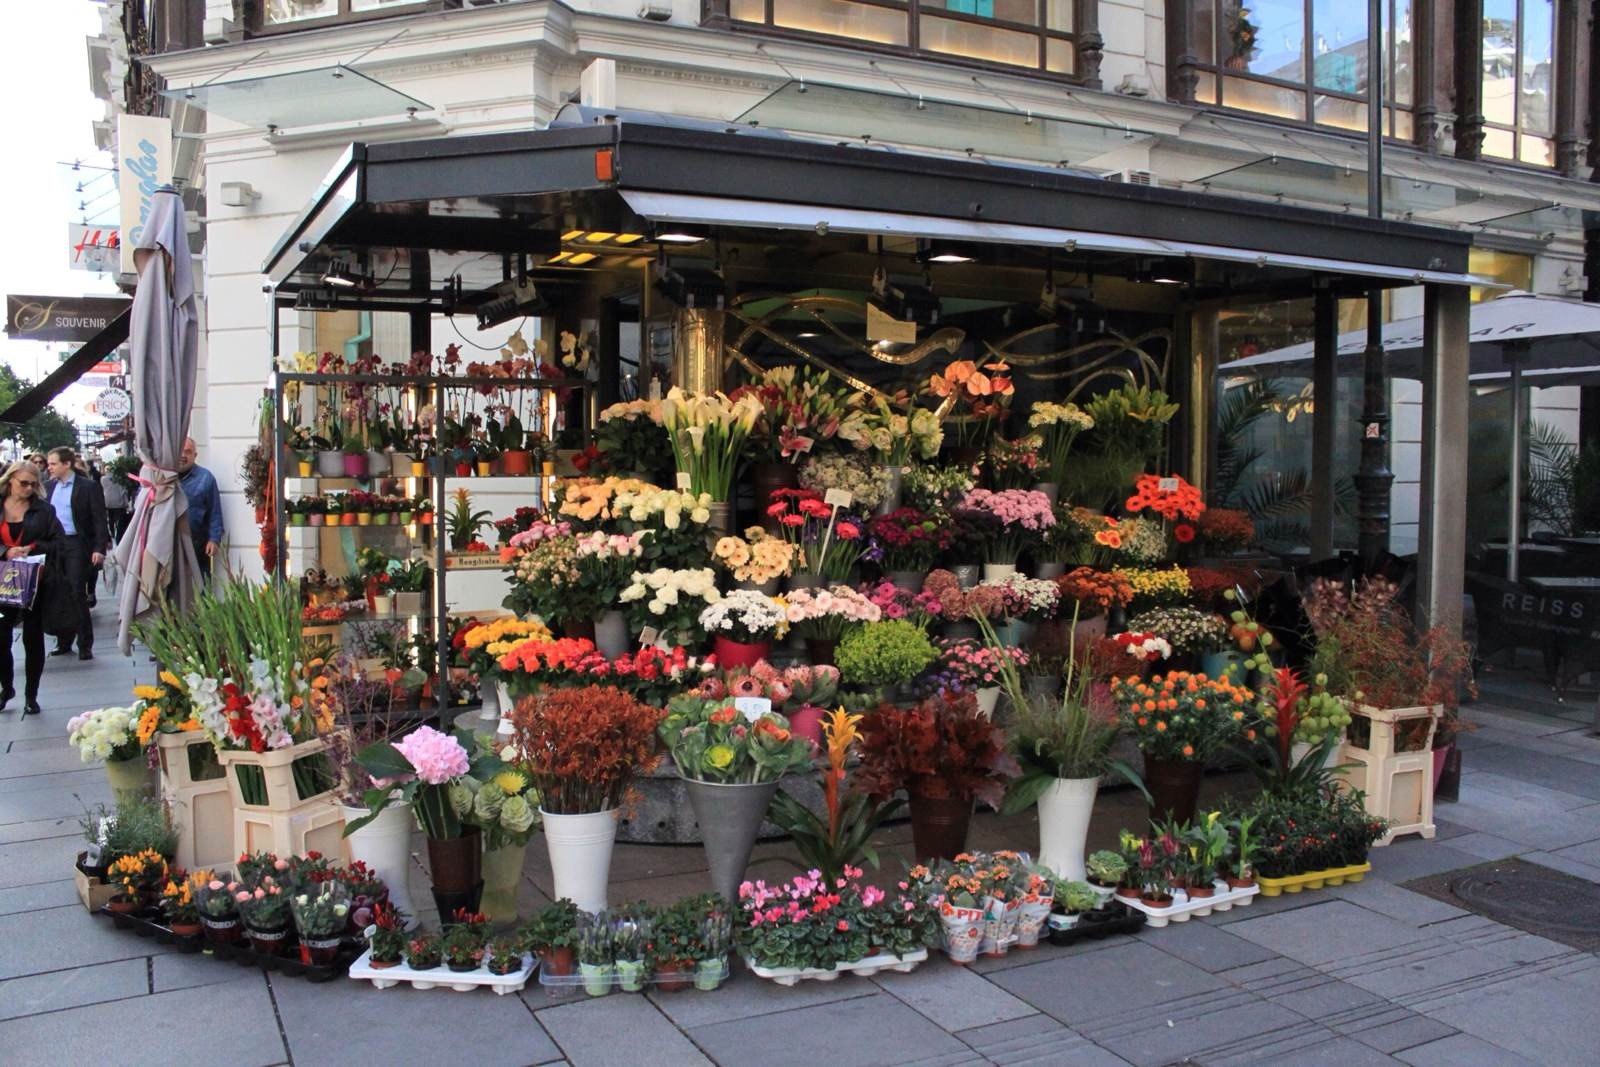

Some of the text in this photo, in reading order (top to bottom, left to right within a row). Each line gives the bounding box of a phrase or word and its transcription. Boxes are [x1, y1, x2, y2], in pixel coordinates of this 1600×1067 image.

[55, 316, 107, 330] SOUVENIR
[96, 401, 129, 410] FRICK
[1502, 592, 1585, 619] REISS
